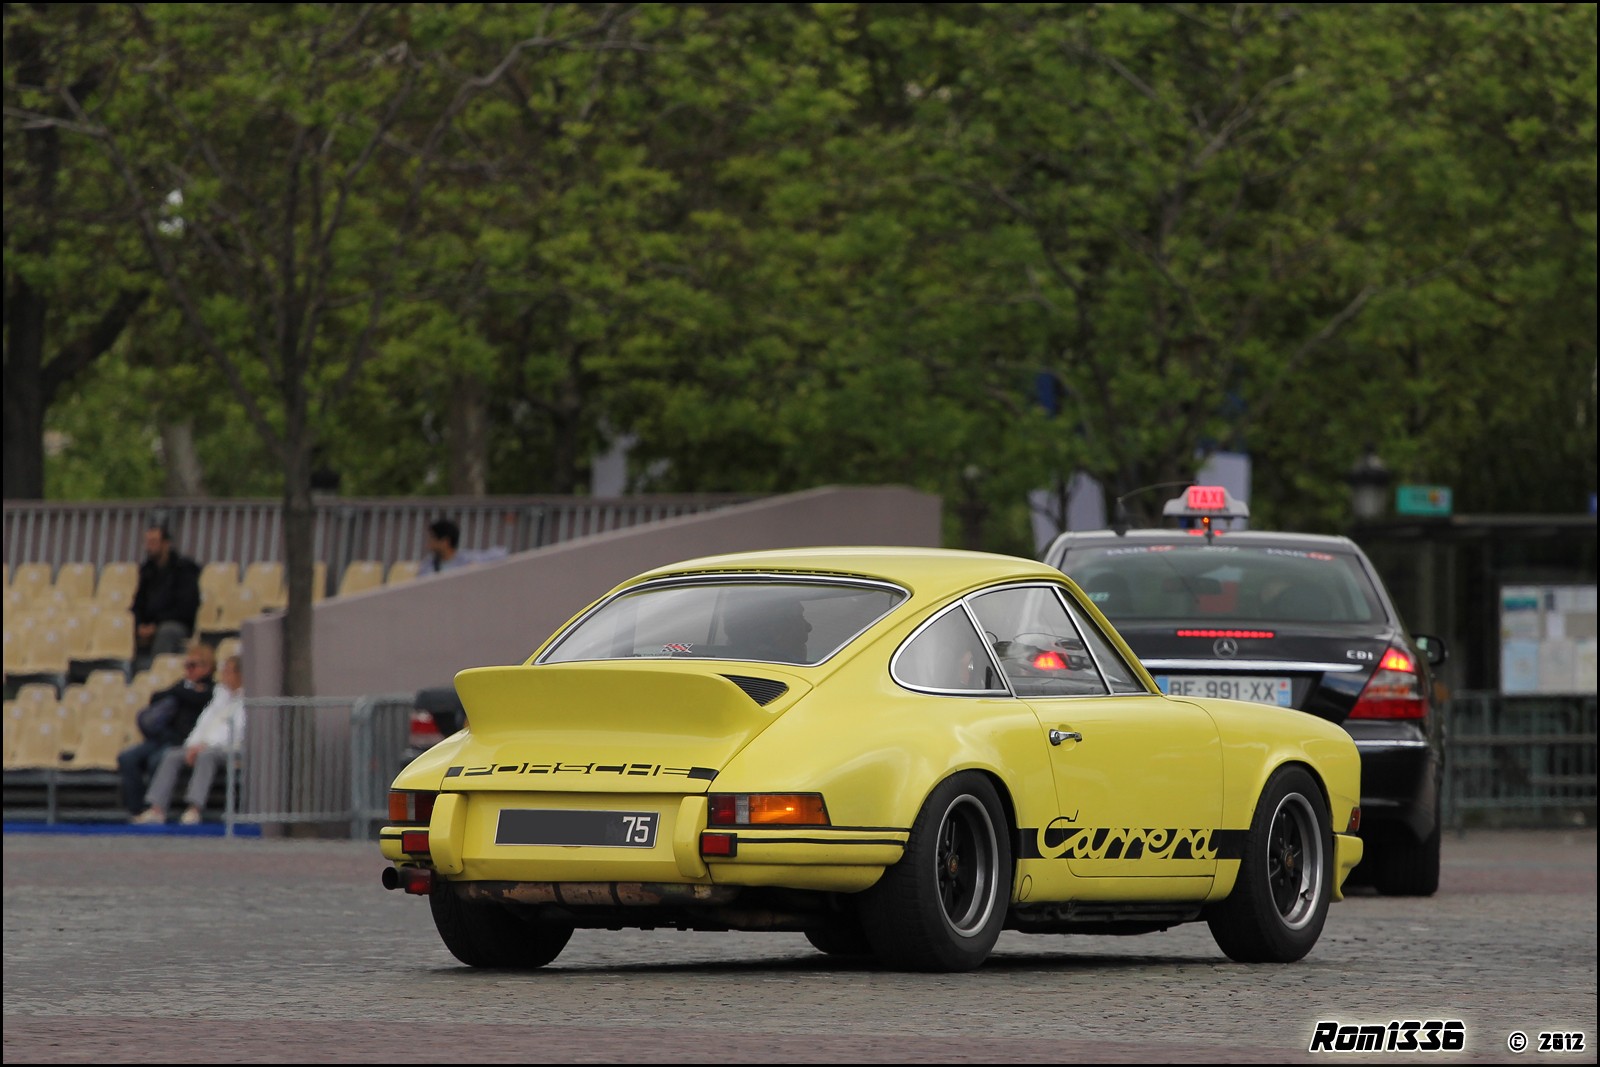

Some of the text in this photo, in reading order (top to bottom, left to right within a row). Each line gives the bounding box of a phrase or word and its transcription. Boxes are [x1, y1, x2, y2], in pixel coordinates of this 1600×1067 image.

[1190, 489, 1225, 504] TAXI
[1346, 650, 1373, 660] CDI
[461, 762, 693, 777] PORSCHE
[622, 816, 651, 843] 75
[1036, 809, 1220, 860] Carrera
